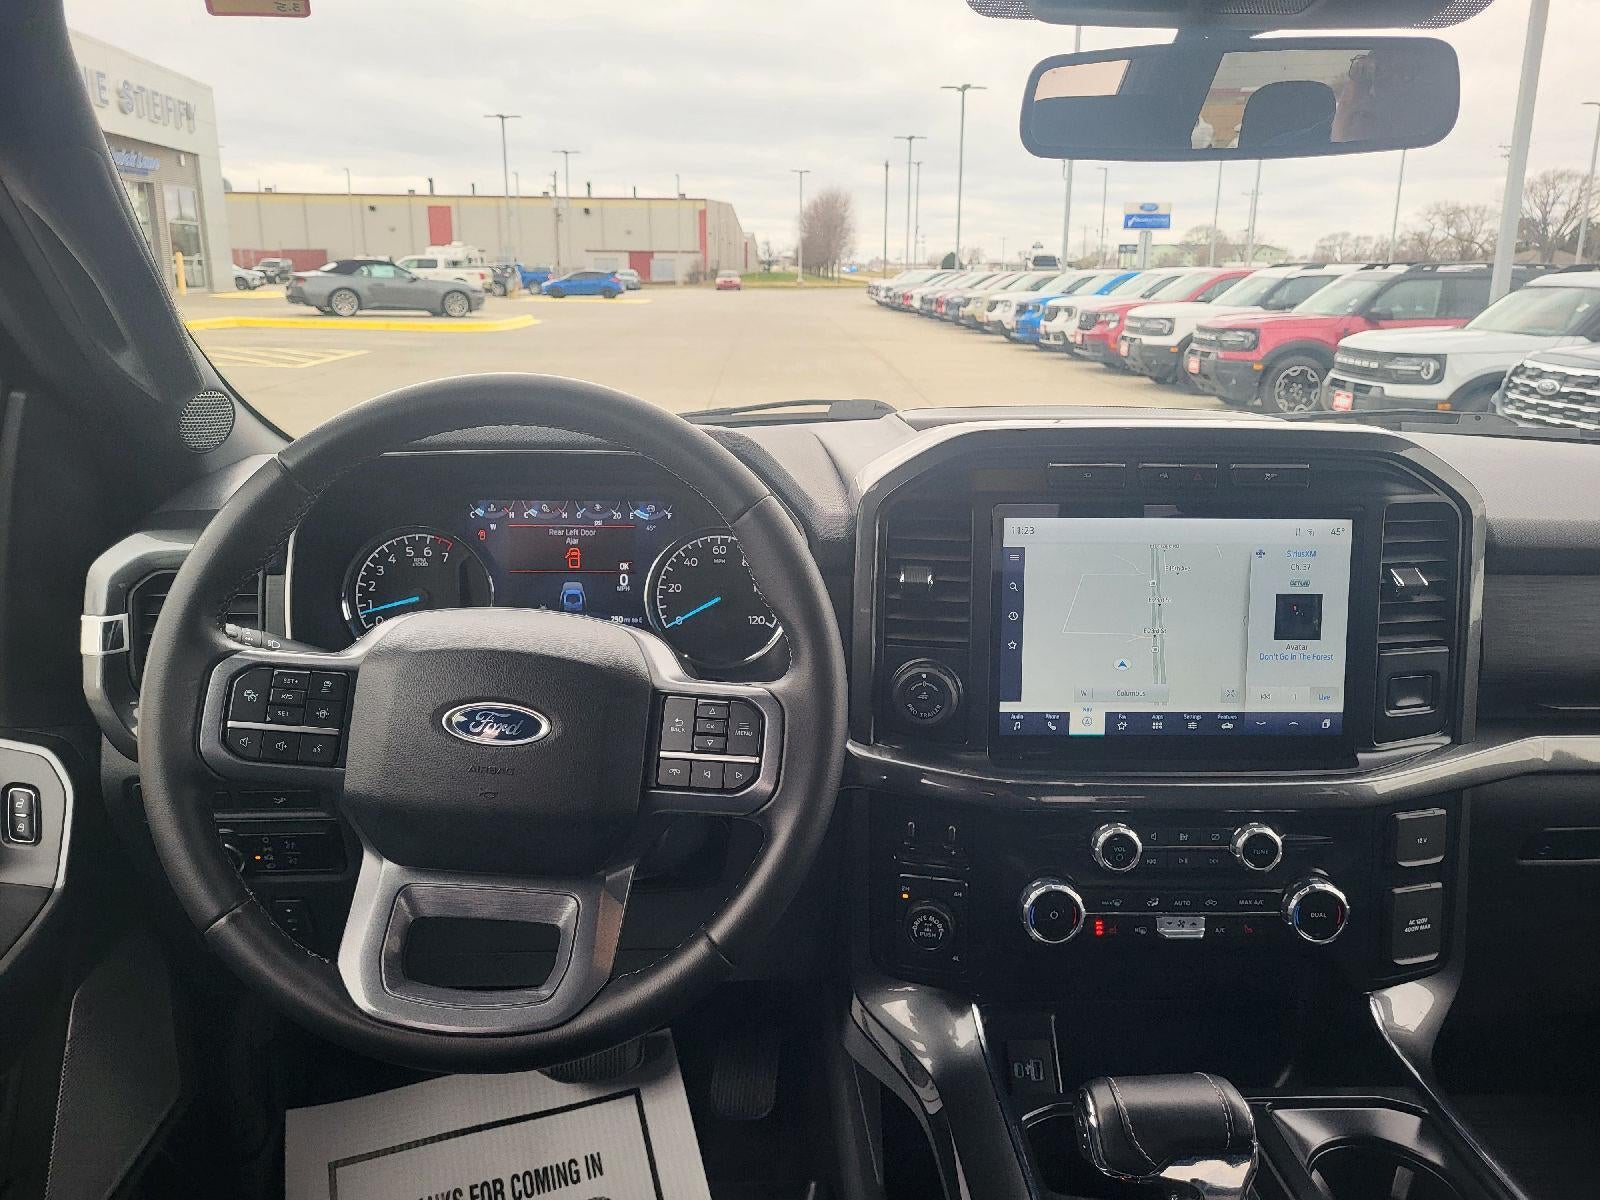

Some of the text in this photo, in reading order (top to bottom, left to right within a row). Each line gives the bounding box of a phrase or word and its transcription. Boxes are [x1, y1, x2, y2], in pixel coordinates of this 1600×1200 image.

[406, 547, 414, 556] 5
[424, 547, 432, 556] 6
[712, 546, 726, 555] 60
[388, 554, 396, 564] 4
[442, 553, 449, 562] 7
[684, 558, 698, 567] 40
[376, 566, 384, 576] 3
[620, 574, 628, 586] 0
[368, 581, 376, 591] 2
[668, 583, 682, 592] 20
[748, 616, 766, 625] 120
[469, 710, 524, 736] Ford
[912, 915, 944, 932] DRIVE MODE
[469, 1178, 506, 1200] FOR
[510, 1158, 582, 1200] COMING
[584, 1152, 604, 1180] IN
